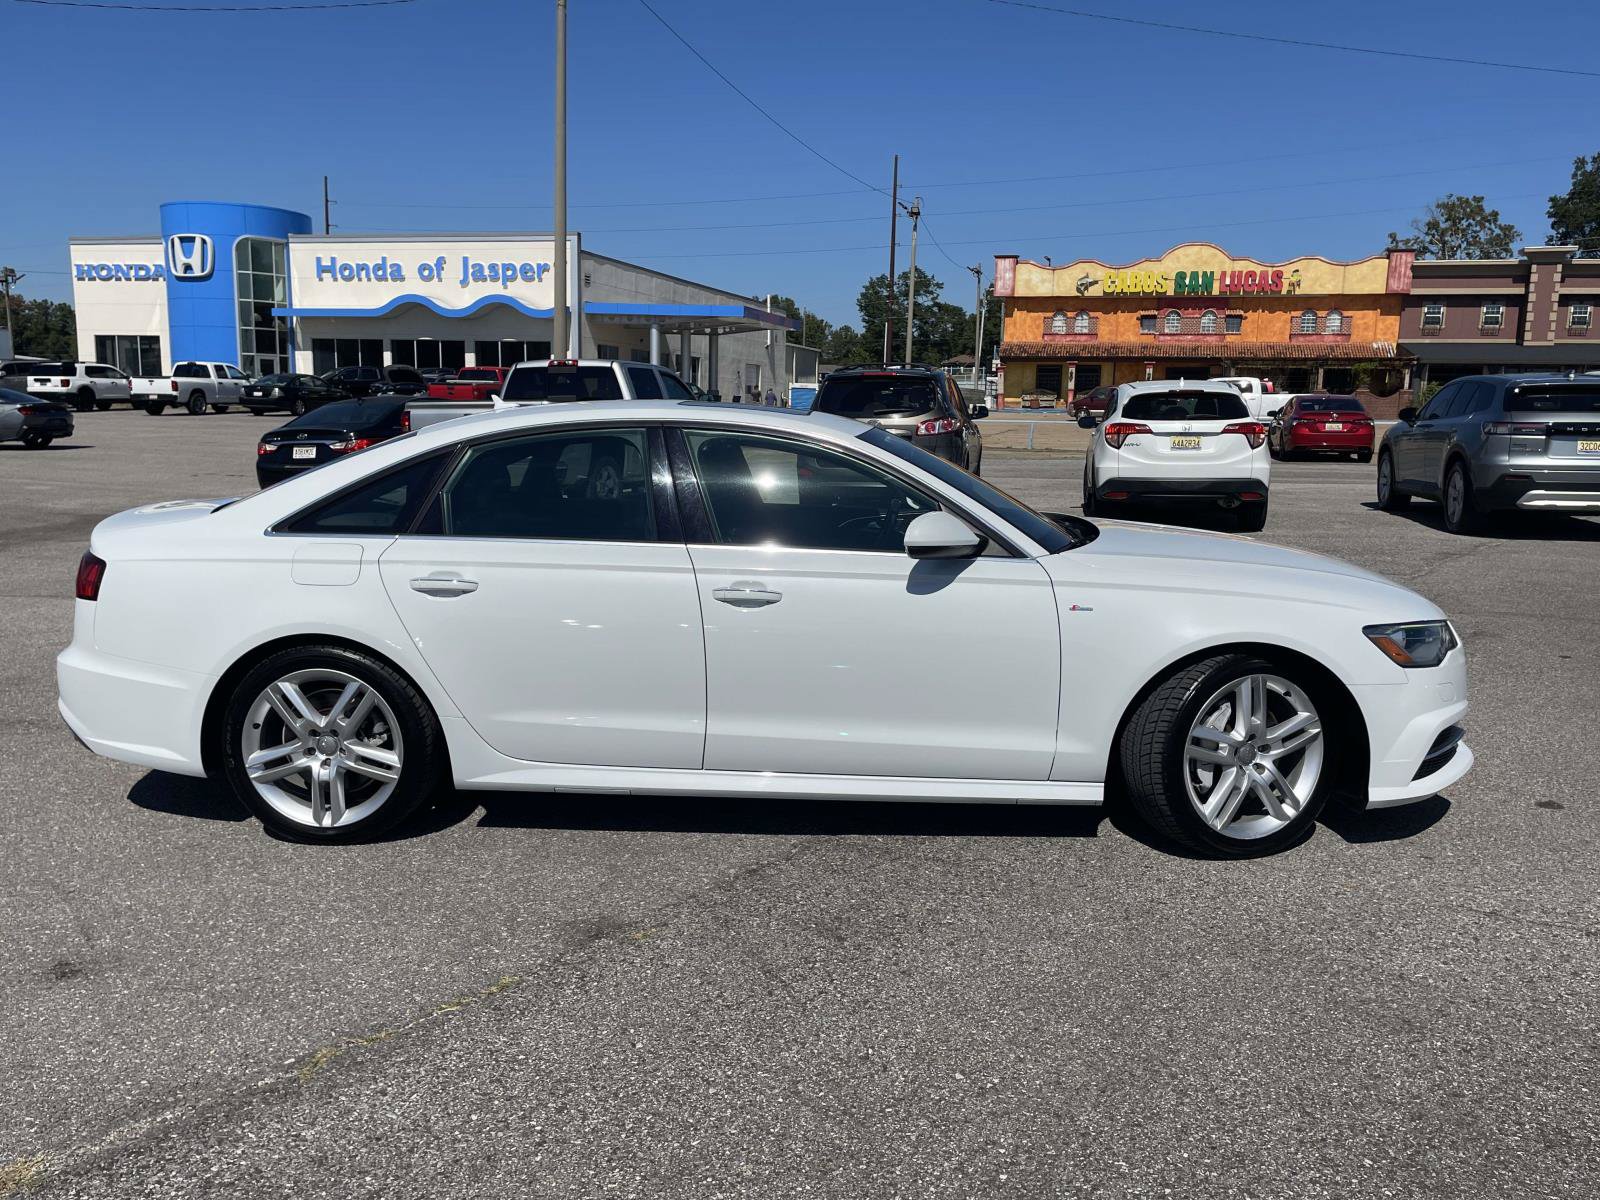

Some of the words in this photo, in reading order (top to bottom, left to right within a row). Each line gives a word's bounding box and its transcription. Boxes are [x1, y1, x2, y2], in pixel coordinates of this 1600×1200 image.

[74, 264, 166, 281] HONDA
[315, 256, 405, 282] Honda
[417, 256, 446, 282] of
[459, 256, 550, 289] Jasper
[1103, 271, 1168, 294] CABOS
[1173, 270, 1214, 294] SAN
[1218, 270, 1284, 294] LUCAS
